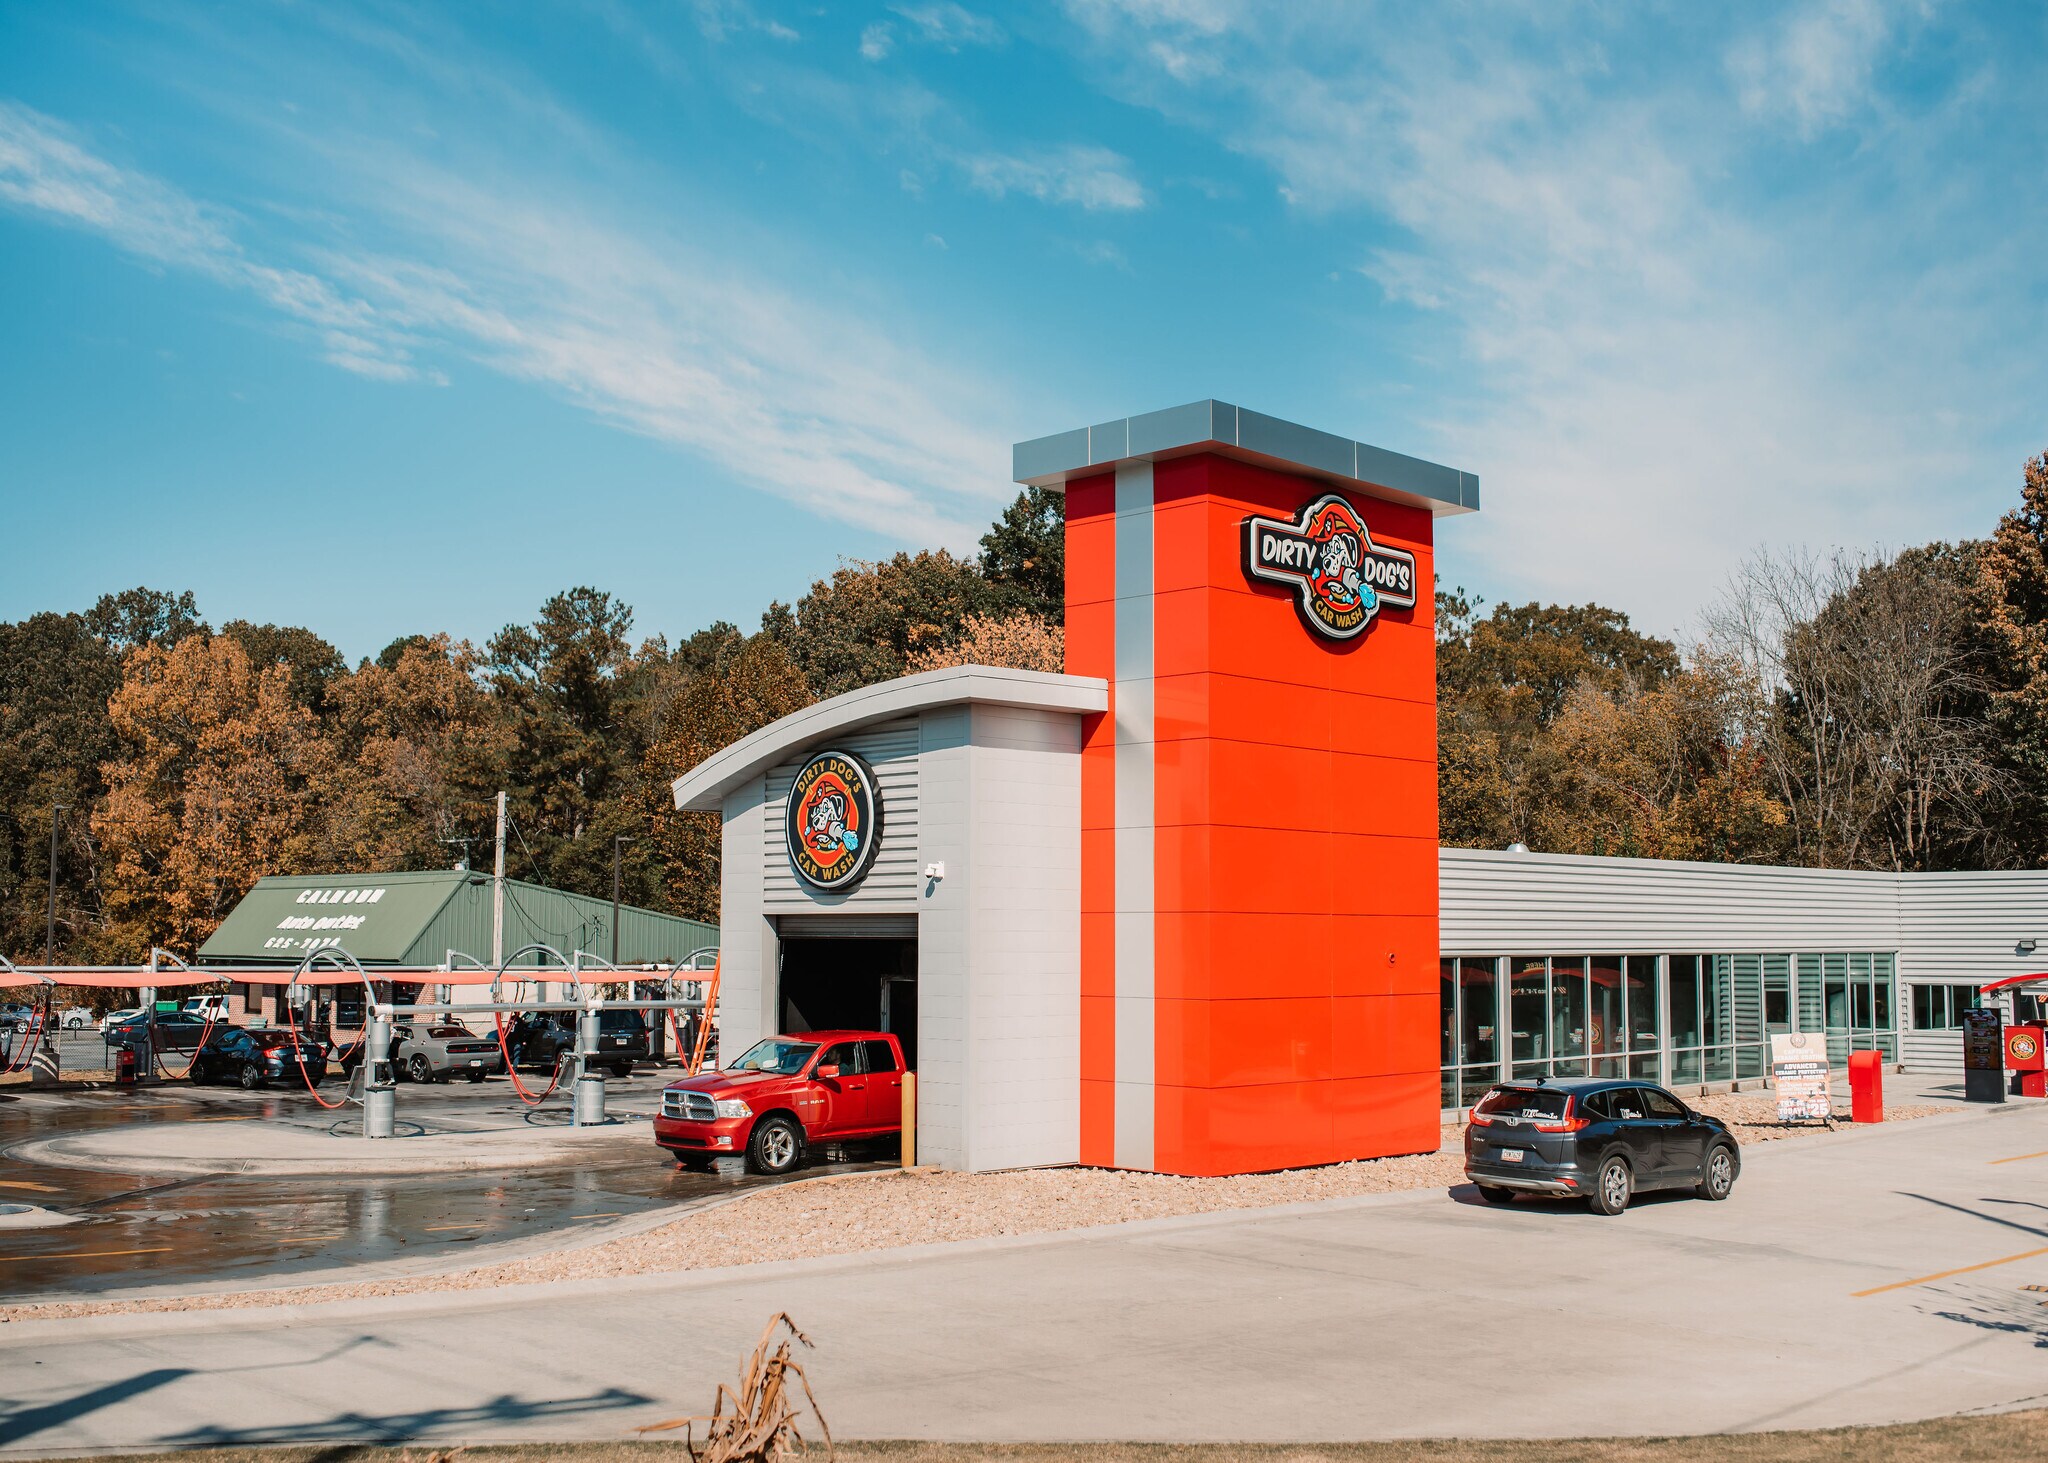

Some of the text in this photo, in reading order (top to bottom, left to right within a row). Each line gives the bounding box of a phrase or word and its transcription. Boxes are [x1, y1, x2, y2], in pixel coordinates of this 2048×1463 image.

[1262, 534, 1410, 591] DIRTY DOG'S
[1315, 601, 1363, 628] CAR WASH
[797, 759, 862, 793] DIRTY DOG'S
[797, 852, 856, 880] CAR WASH
[296, 888, 386, 904] CALHOUN
[276, 915, 315, 930] Auto
